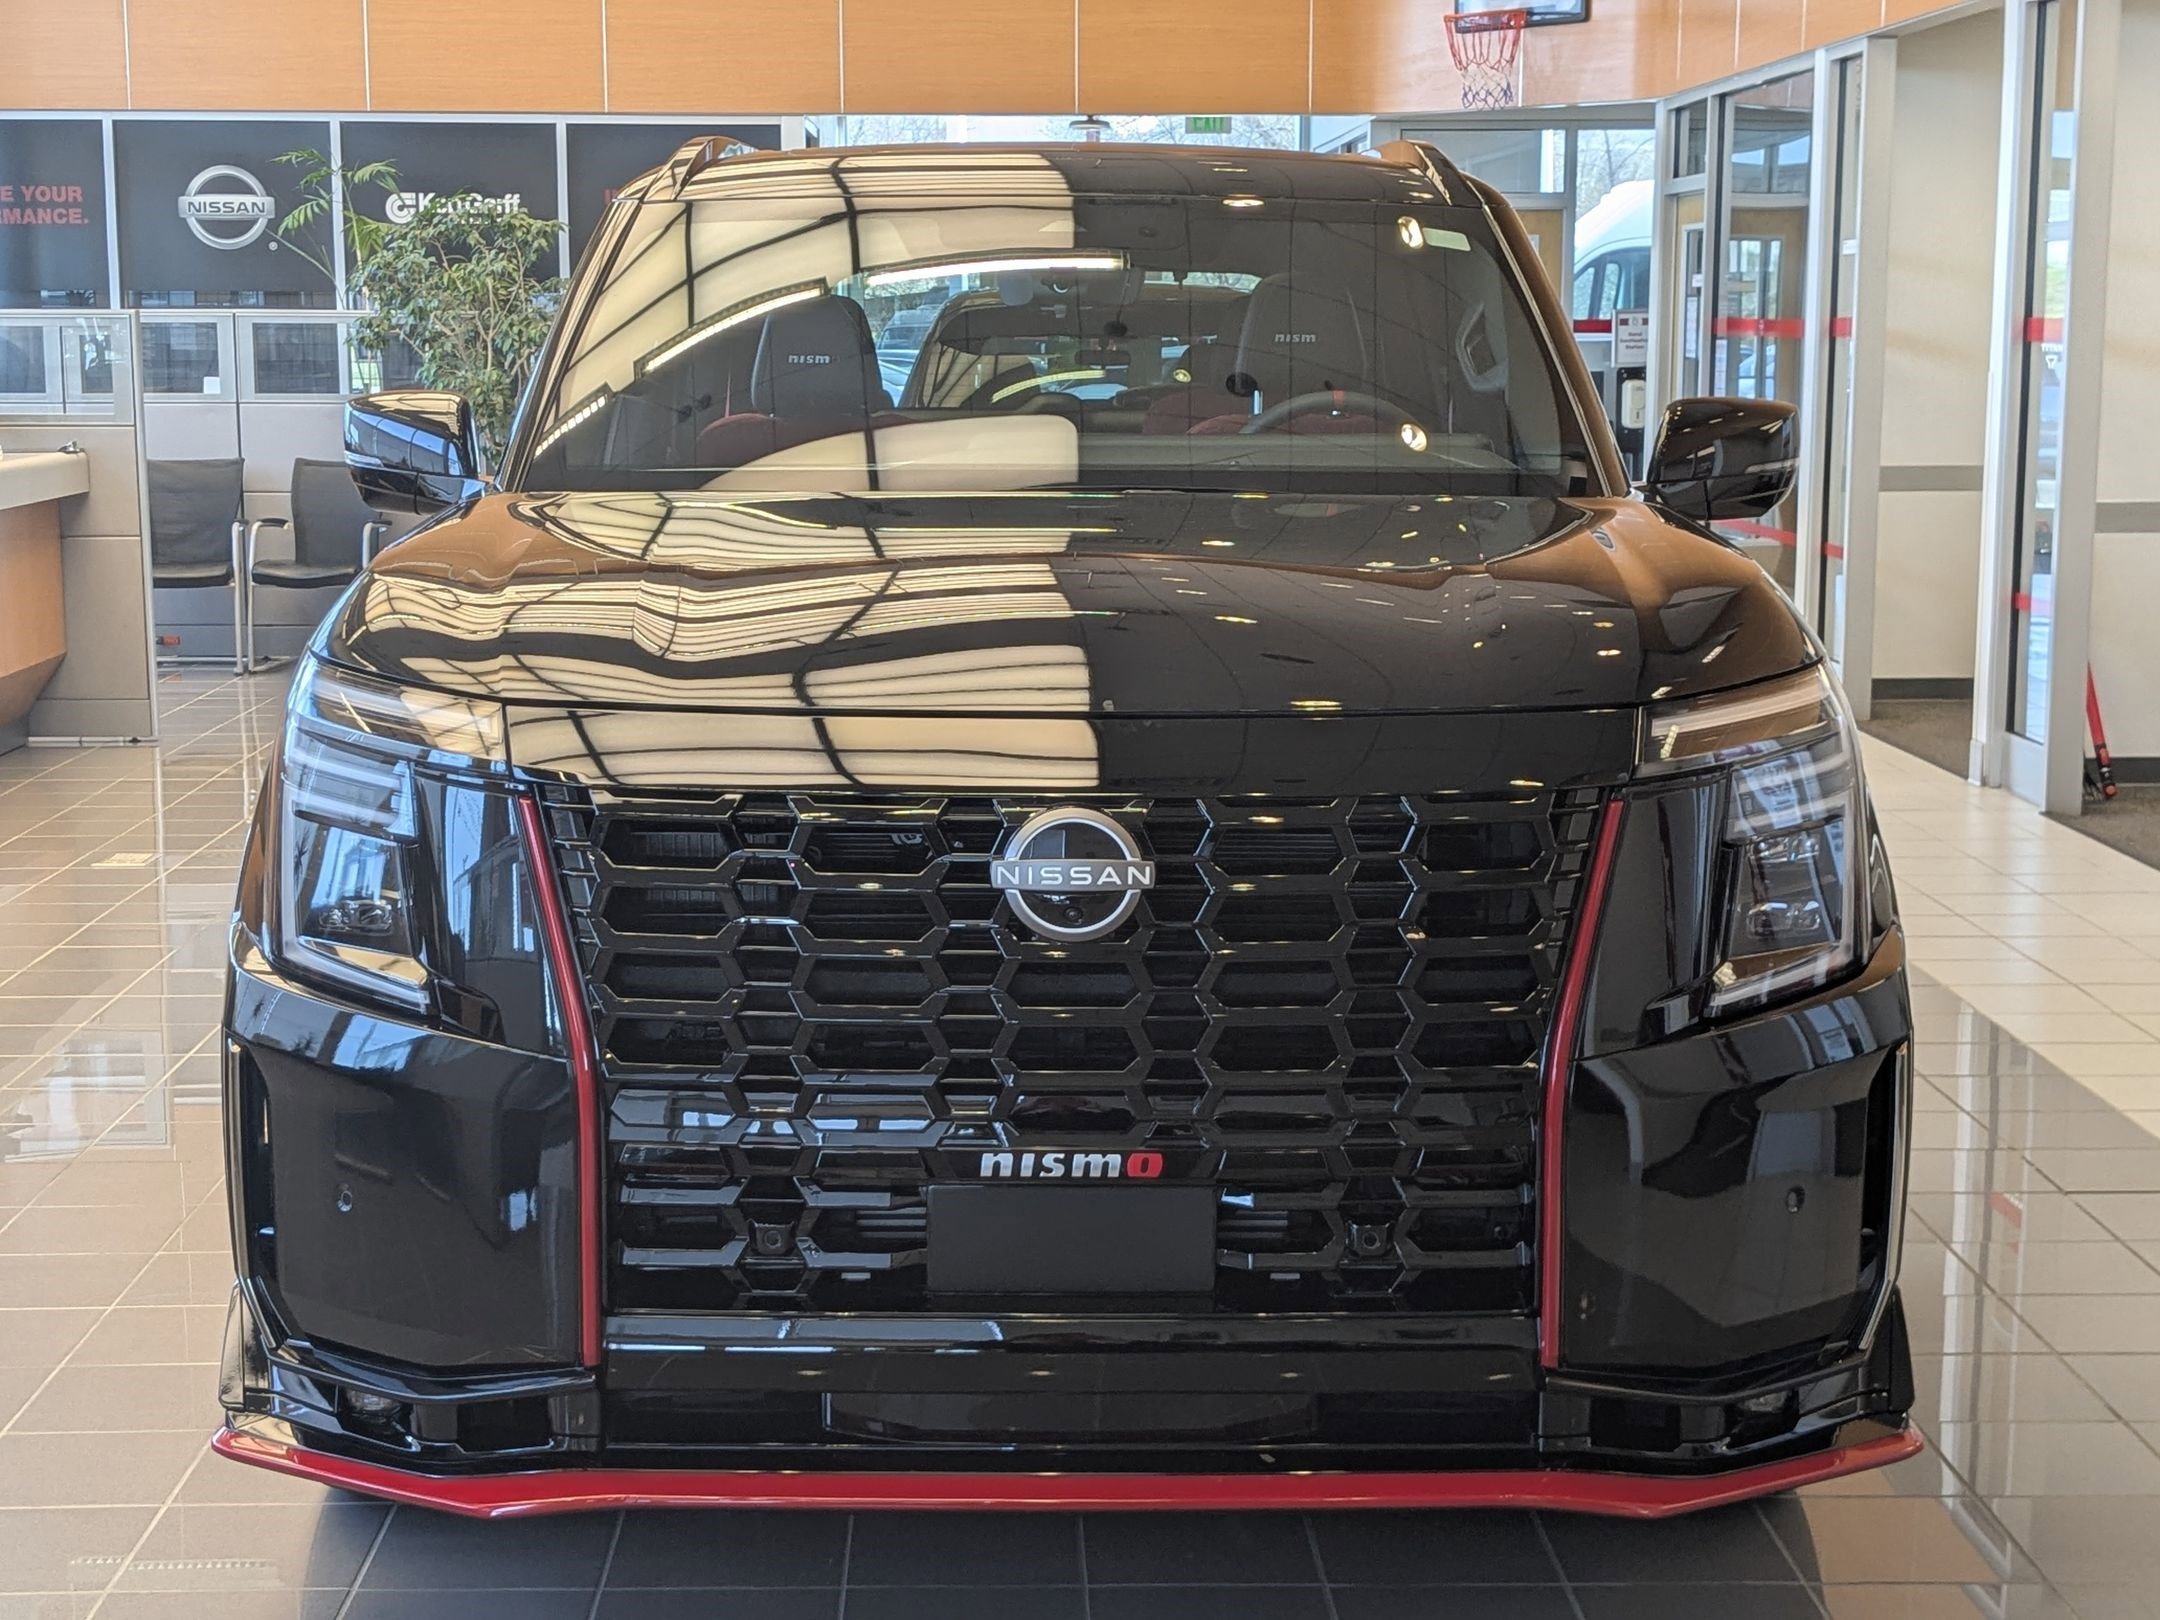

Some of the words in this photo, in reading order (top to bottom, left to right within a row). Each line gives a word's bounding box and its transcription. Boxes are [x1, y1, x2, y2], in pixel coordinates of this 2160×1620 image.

[20, 185, 83, 202] YOUR
[0, 207, 89, 224] MANCE.
[187, 201, 265, 213] NISSAN
[996, 866, 1151, 885] NISSAN
[979, 1152, 1164, 1178] nismo
